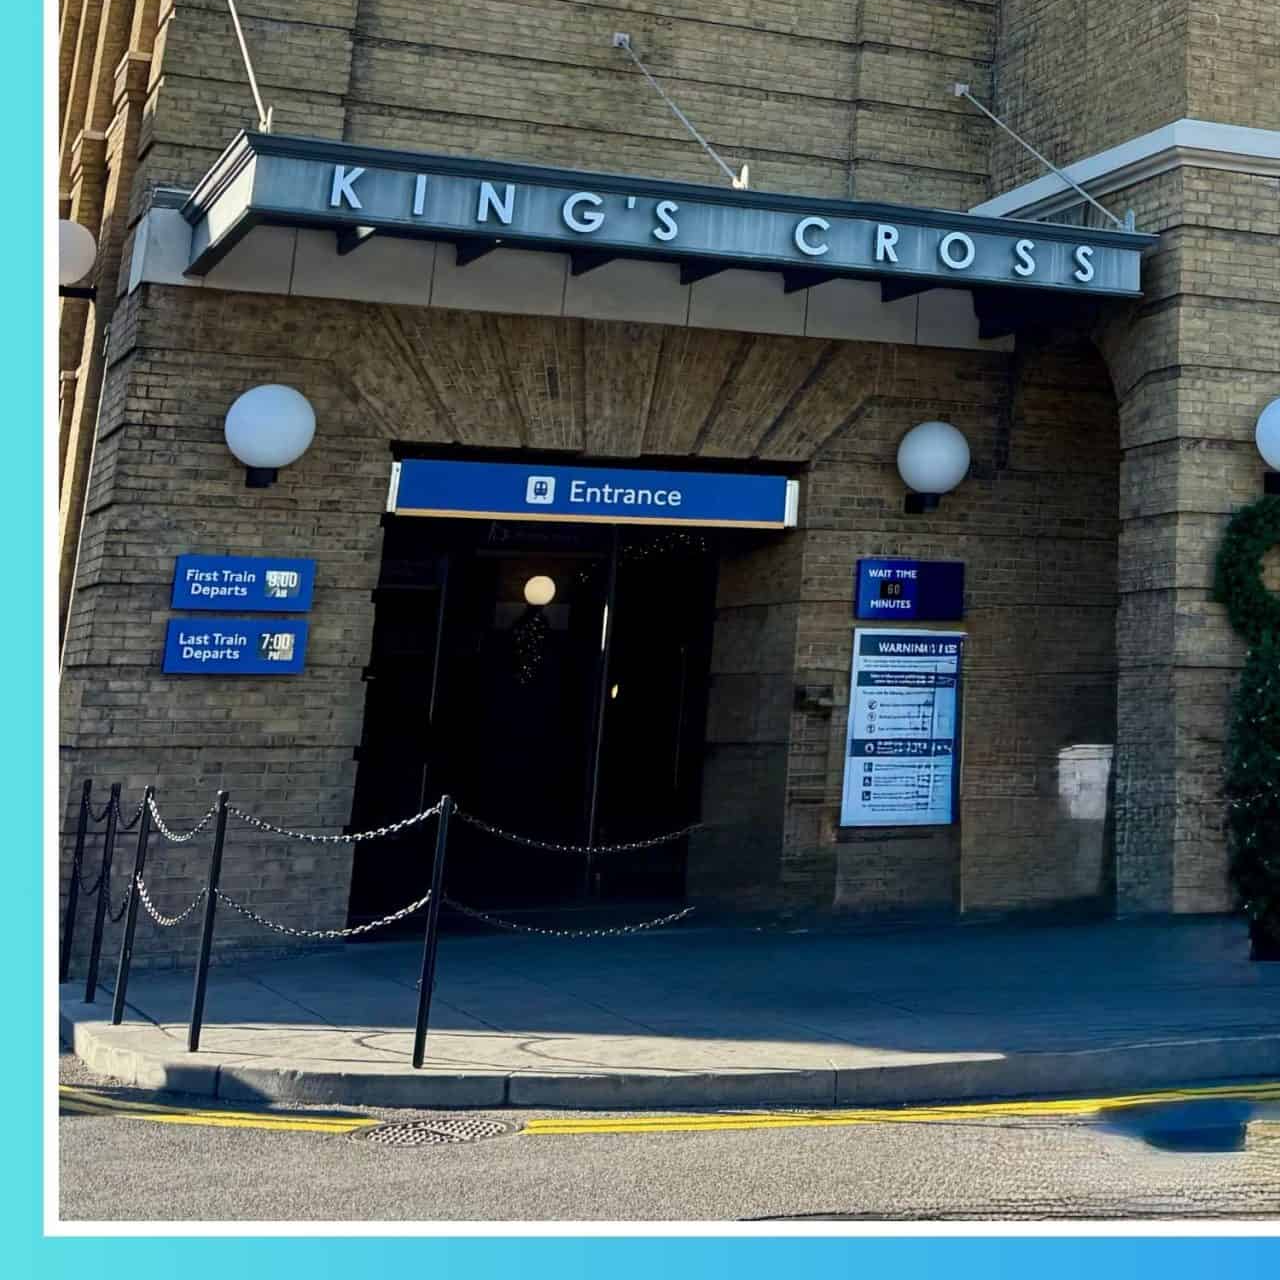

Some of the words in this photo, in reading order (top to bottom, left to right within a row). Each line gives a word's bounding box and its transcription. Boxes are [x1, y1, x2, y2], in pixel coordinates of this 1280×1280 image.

[330, 164, 679, 242] KING'S
[795, 215, 1096, 284] CROSS
[570, 480, 682, 507] Entrance
[186, 569, 218, 582] First
[222, 570, 256, 583] Train
[868, 569, 892, 579] WAIT
[896, 570, 917, 579] TIME
[191, 584, 248, 598] Departs
[870, 600, 911, 609] MINUTES
[179, 632, 209, 646] Last
[212, 633, 247, 646] Train
[261, 633, 290, 649] 7:00
[182, 647, 240, 662] Departs
